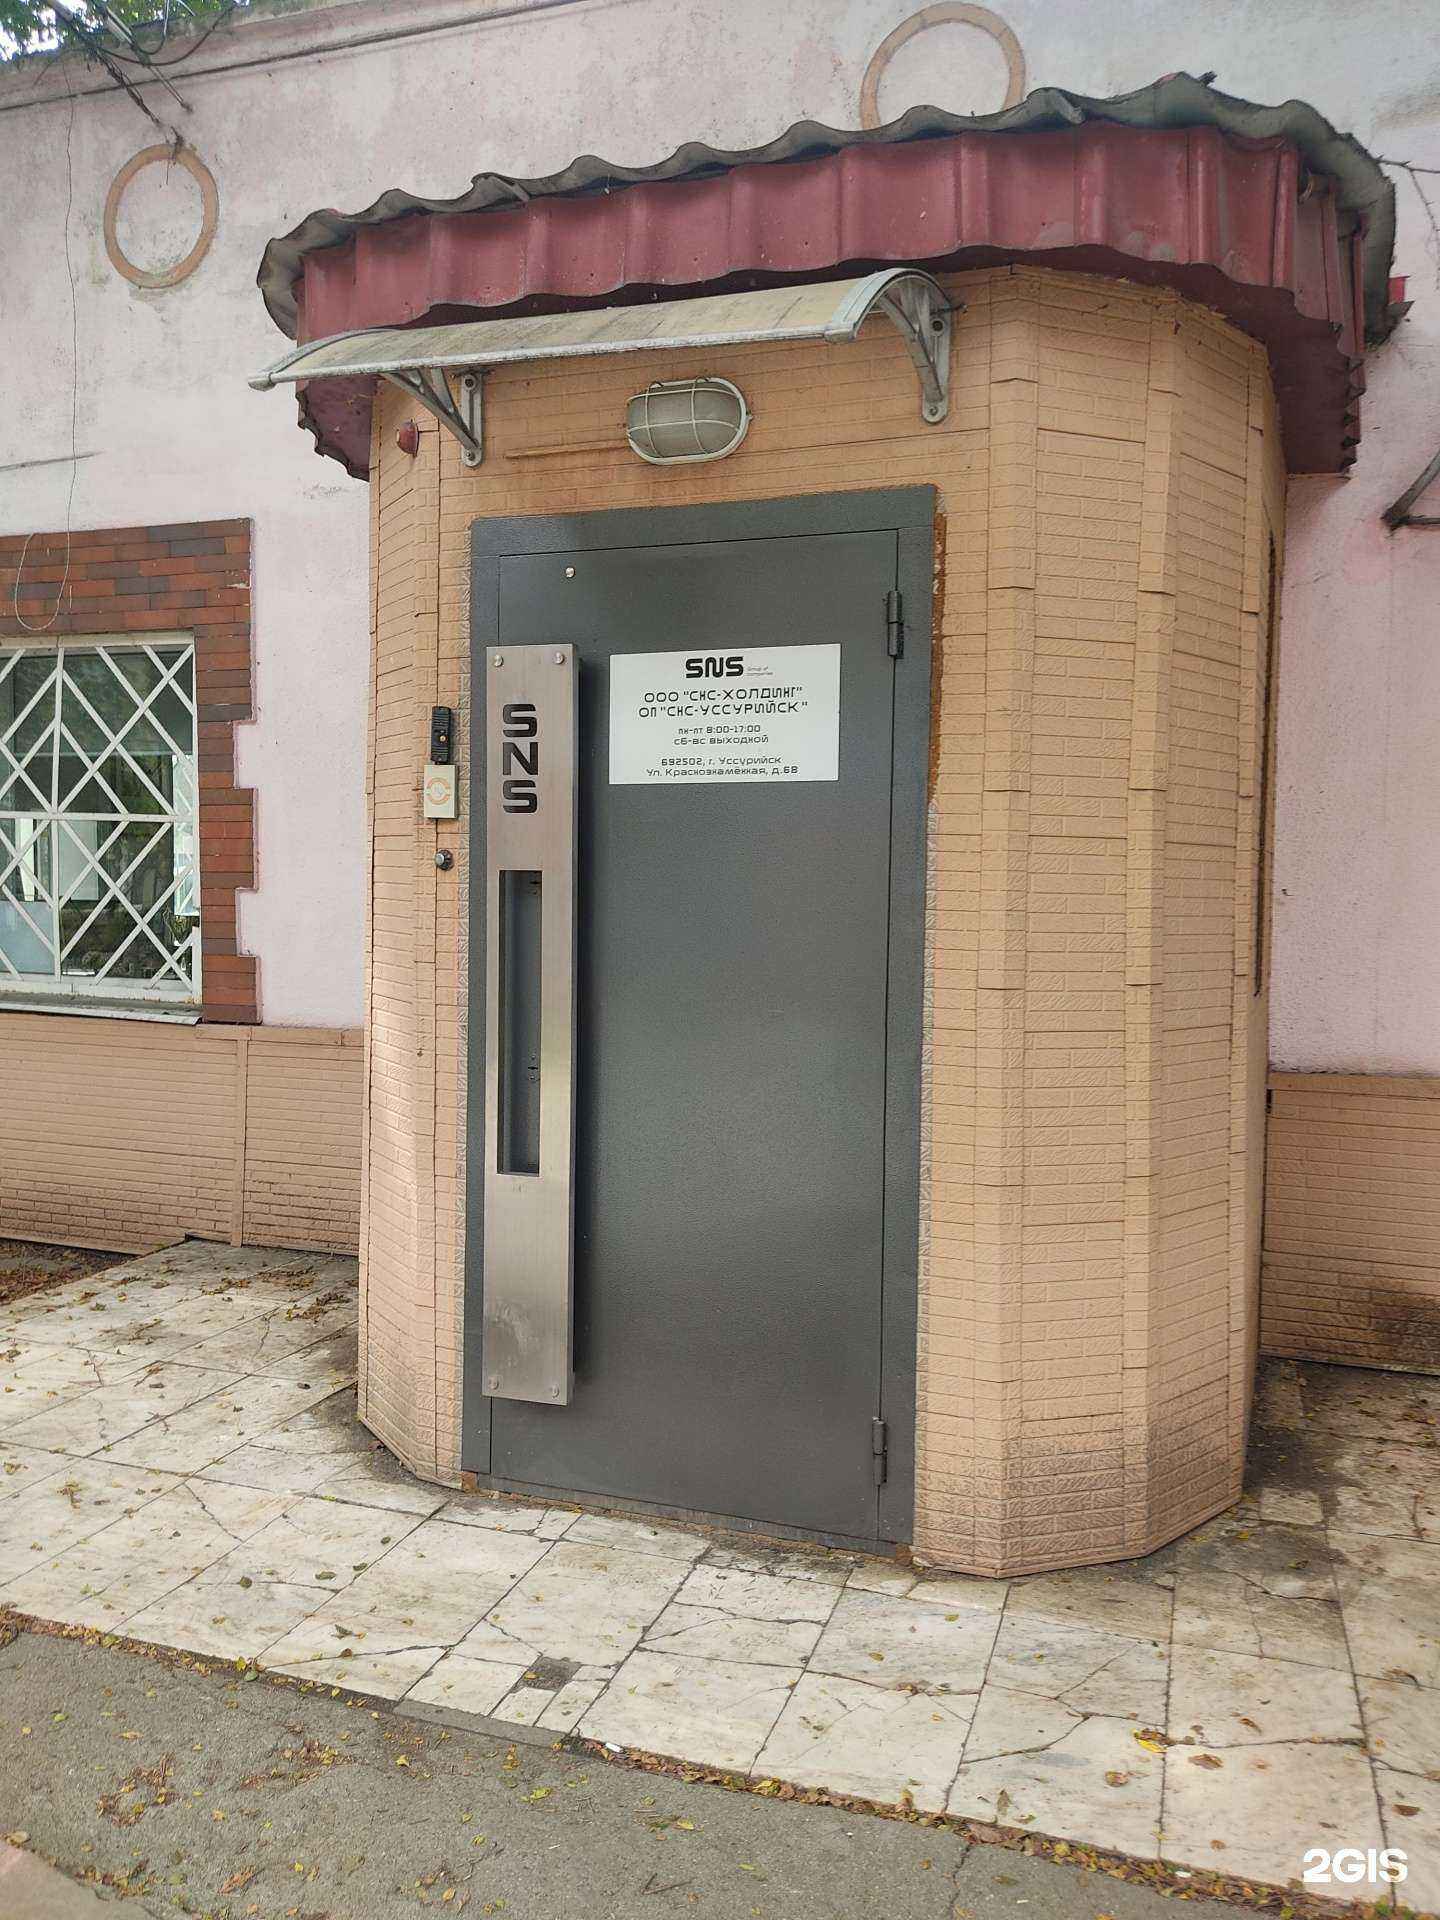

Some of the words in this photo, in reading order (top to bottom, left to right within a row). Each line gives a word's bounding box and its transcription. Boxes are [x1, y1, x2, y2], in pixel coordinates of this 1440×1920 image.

[685, 656, 744, 678] SNS
[644, 692, 679, 702] ООО
[683, 687, 803, 701] "СНС-ХОЛДИНГ"
[638, 707, 657, 718] ОП
[660, 700, 808, 717] "СНС-УССУРИЙСК"
[706, 725, 761, 734] 8:00-17:00
[709, 734, 769, 744] выходной
[503, 704, 538, 813] SNS
[719, 755, 782, 765] Уссурийск
